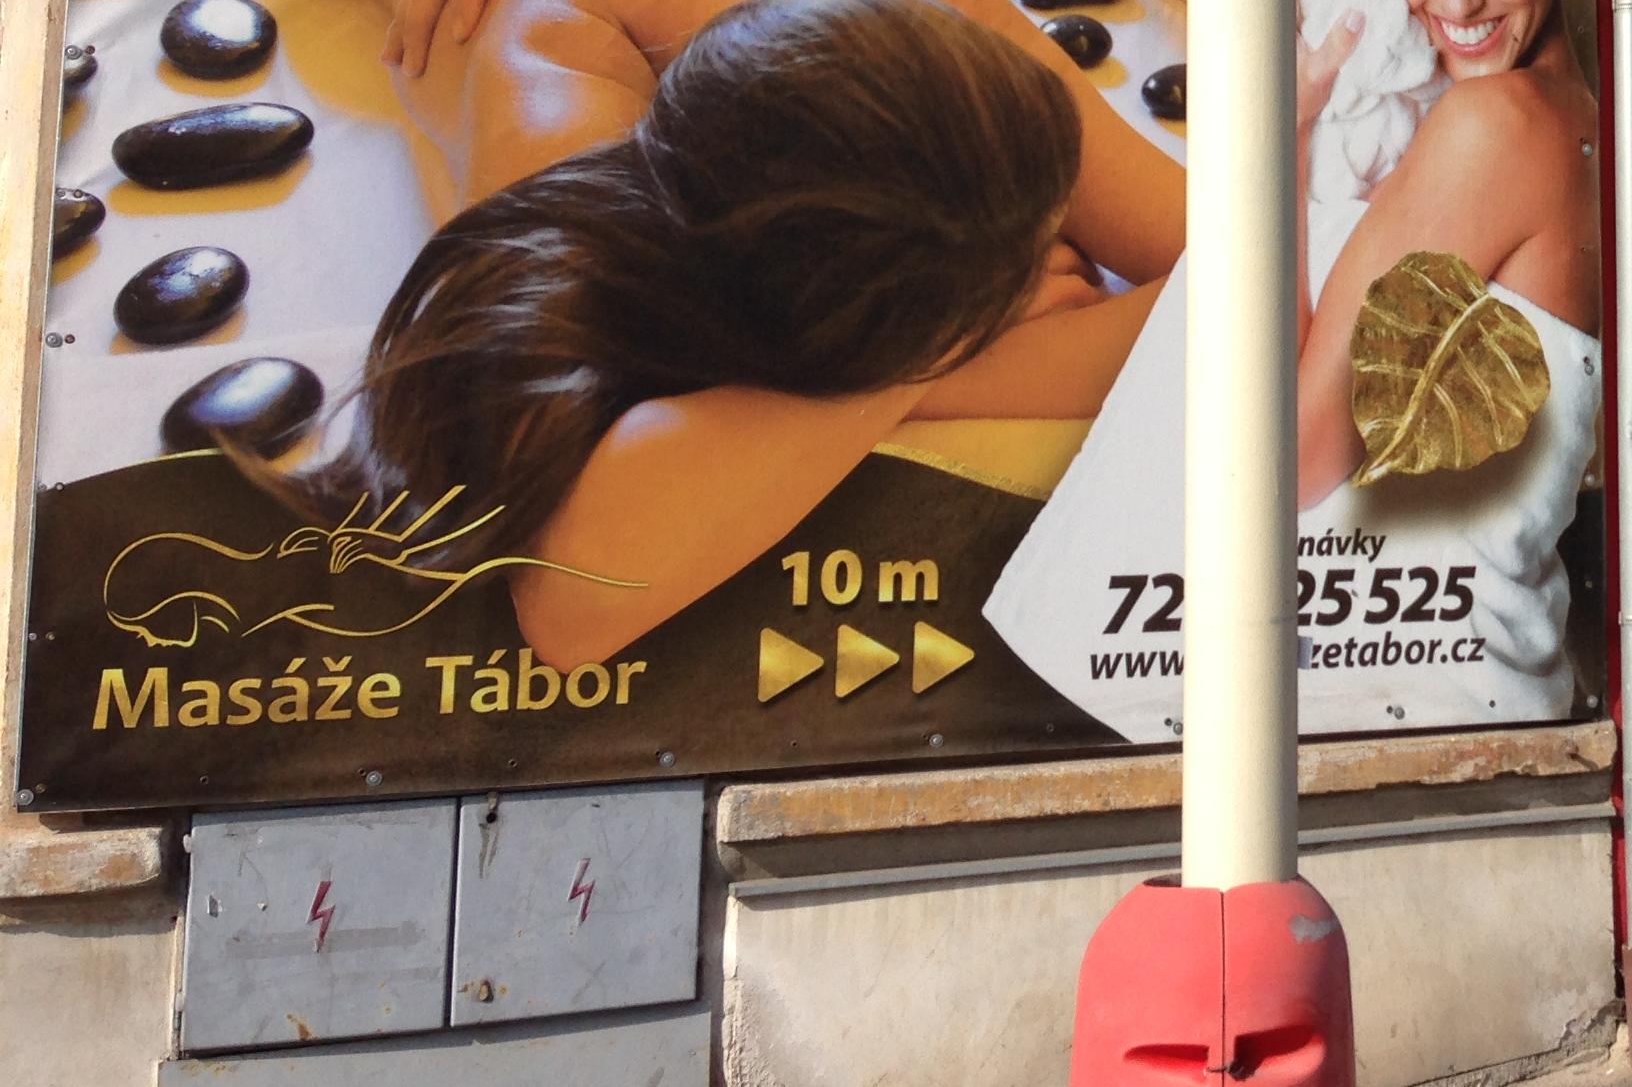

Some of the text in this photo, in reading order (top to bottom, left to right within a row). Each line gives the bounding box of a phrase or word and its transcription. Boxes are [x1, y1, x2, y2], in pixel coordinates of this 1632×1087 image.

[1298, 528, 1387, 563] návky
[781, 550, 939, 607] 10 m
[1102, 566, 1476, 635] 72 25 525
[92, 647, 648, 730] Masáže Tábor
